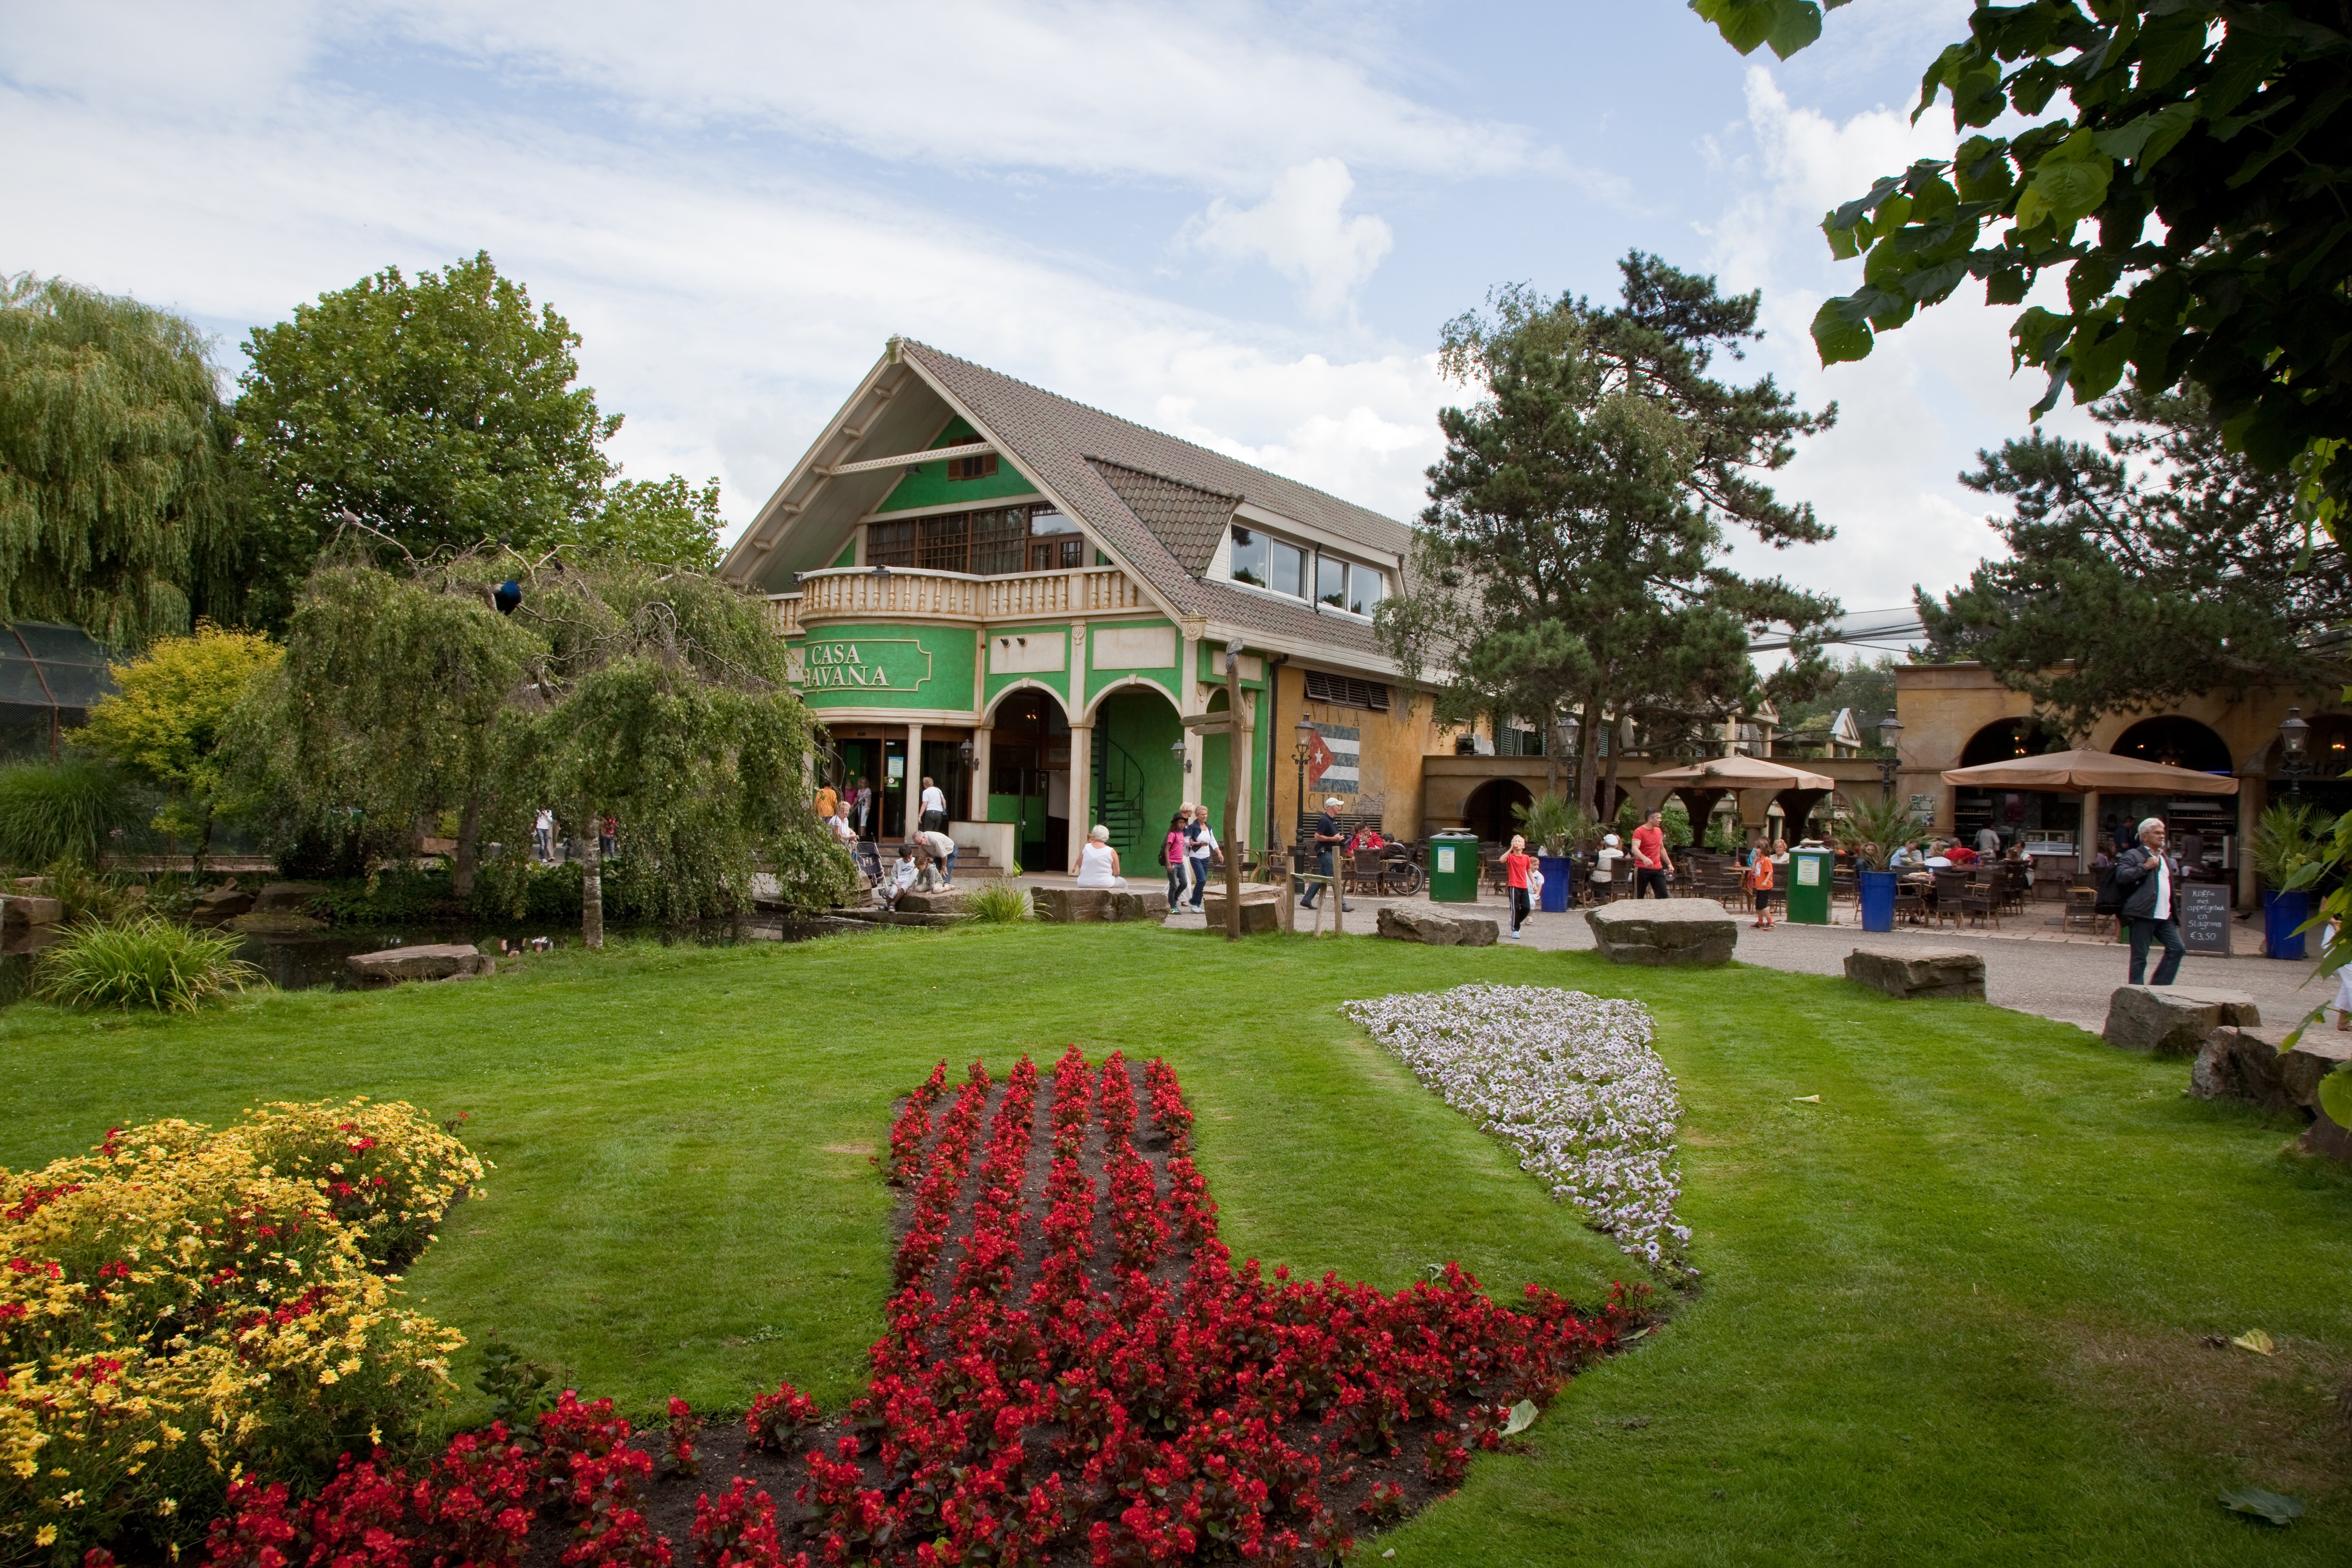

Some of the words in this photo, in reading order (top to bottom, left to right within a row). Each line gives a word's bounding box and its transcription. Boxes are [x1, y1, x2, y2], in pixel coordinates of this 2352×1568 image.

[812, 644, 862, 665] CASA
[1311, 703, 1360, 727] VIVA
[2187, 905, 2225, 913] appelgebak
